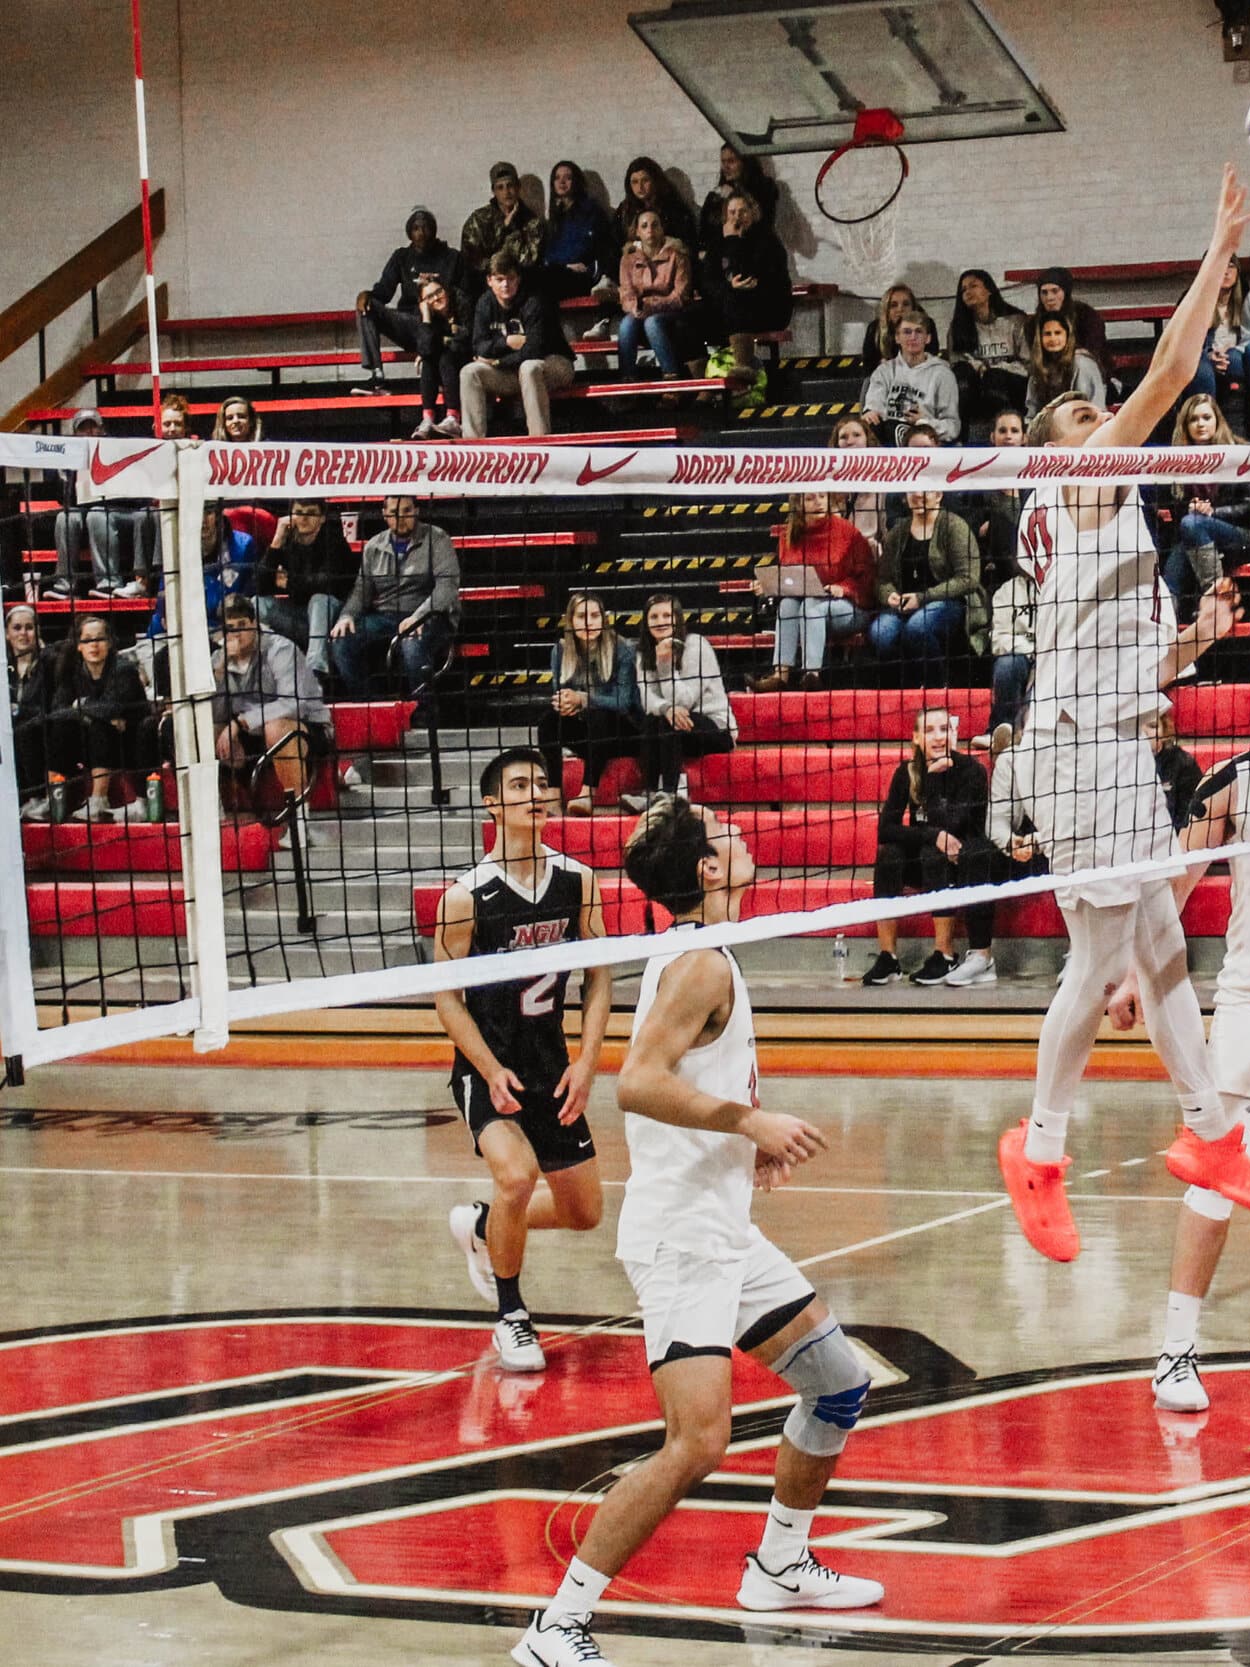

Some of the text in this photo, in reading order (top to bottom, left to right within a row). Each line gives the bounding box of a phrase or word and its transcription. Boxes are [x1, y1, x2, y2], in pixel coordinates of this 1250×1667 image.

[35, 441, 66, 454] SPALDING
[208, 448, 549, 487] NORTH GREENVILLE UNIVERSITY
[668, 454, 931, 484] NORTH GREENVILLE UNIVERSITY
[1017, 452, 1226, 480] NORTH GREENVILLE UNIVERSITY
[513, 918, 570, 948] NGU
